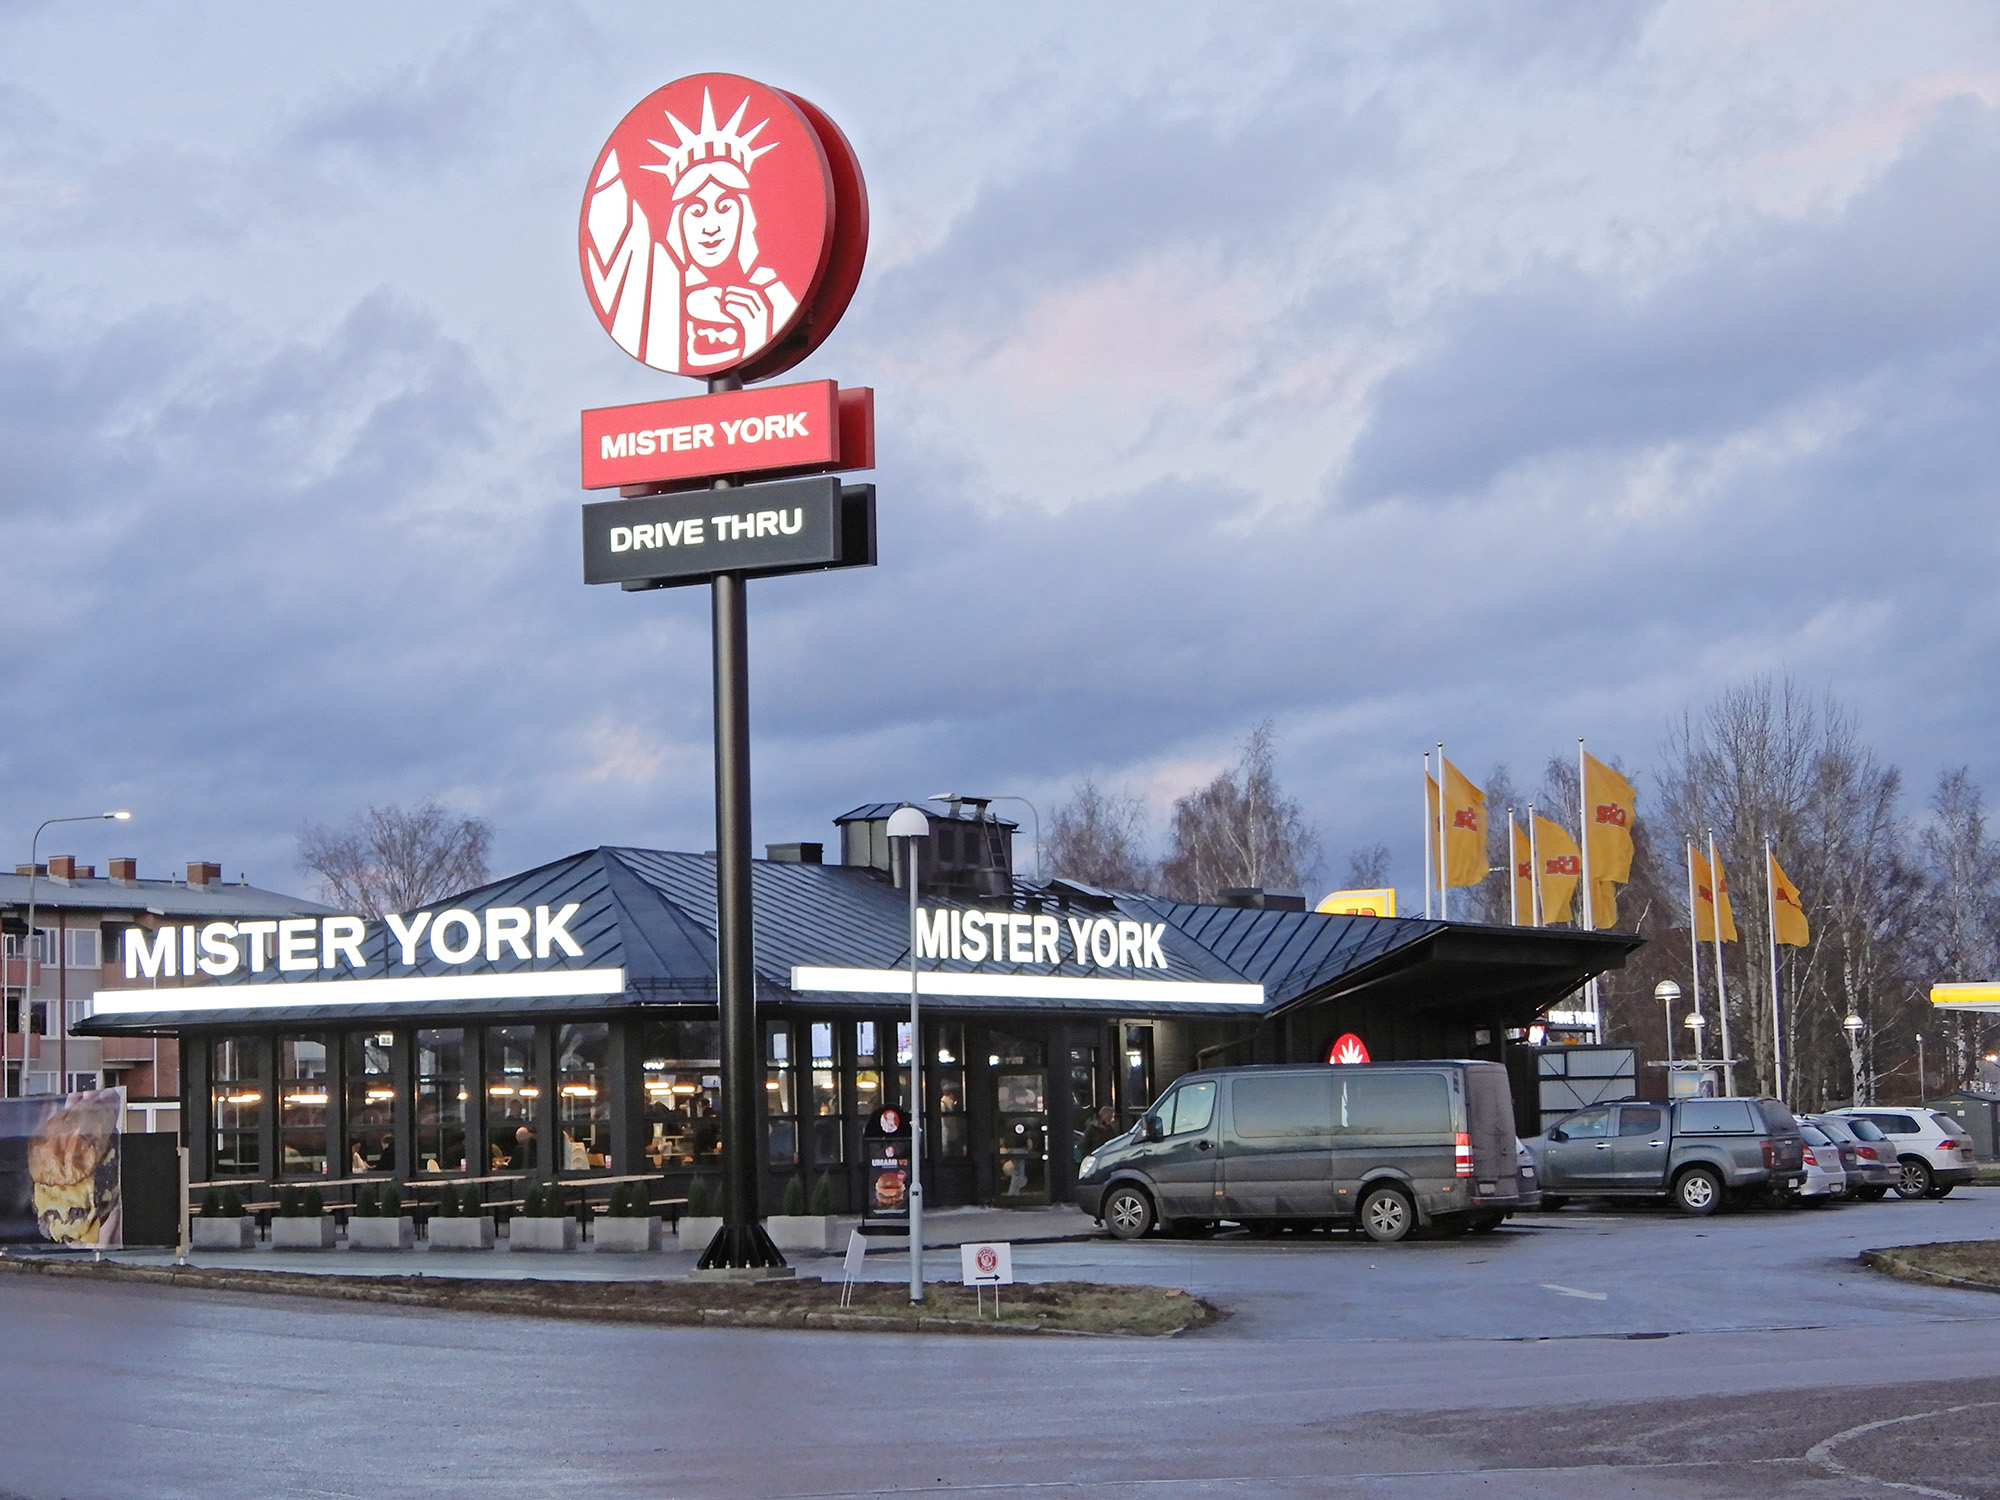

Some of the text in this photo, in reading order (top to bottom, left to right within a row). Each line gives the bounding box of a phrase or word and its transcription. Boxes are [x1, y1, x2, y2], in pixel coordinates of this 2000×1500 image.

[601, 411, 809, 459] MISTER YORK
[610, 508, 802, 552] DRIVE THRU
[123, 903, 585, 979] MISTER YORK
[916, 907, 1168, 969] MISTER YORK
[871, 1158, 898, 1167] UMAMI
